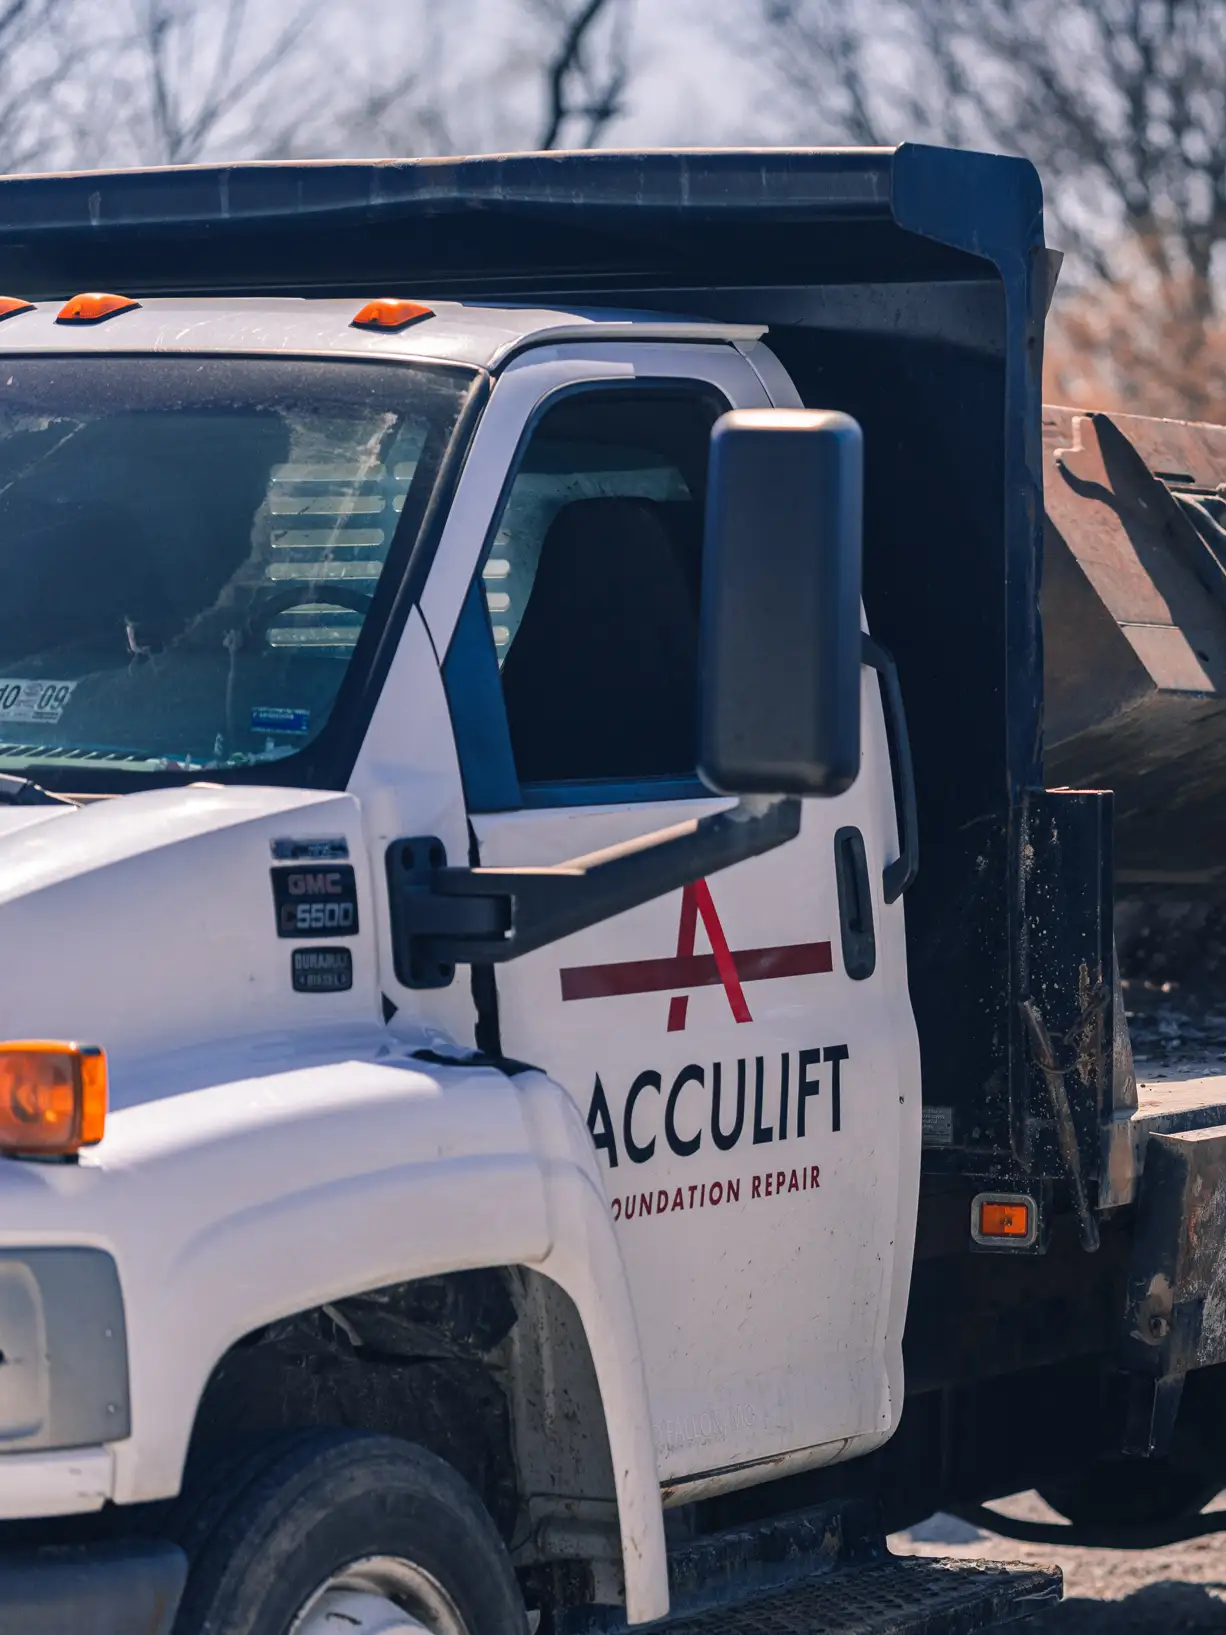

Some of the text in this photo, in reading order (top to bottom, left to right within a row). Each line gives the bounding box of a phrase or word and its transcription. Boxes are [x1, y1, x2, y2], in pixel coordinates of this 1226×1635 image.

[37, 684, 70, 710] 09
[288, 872, 342, 895] GMC
[281, 902, 354, 931] C5500
[586, 1044, 849, 1168] ACCULIFT
[611, 1165, 821, 1222] OUNDATION REPAIR
